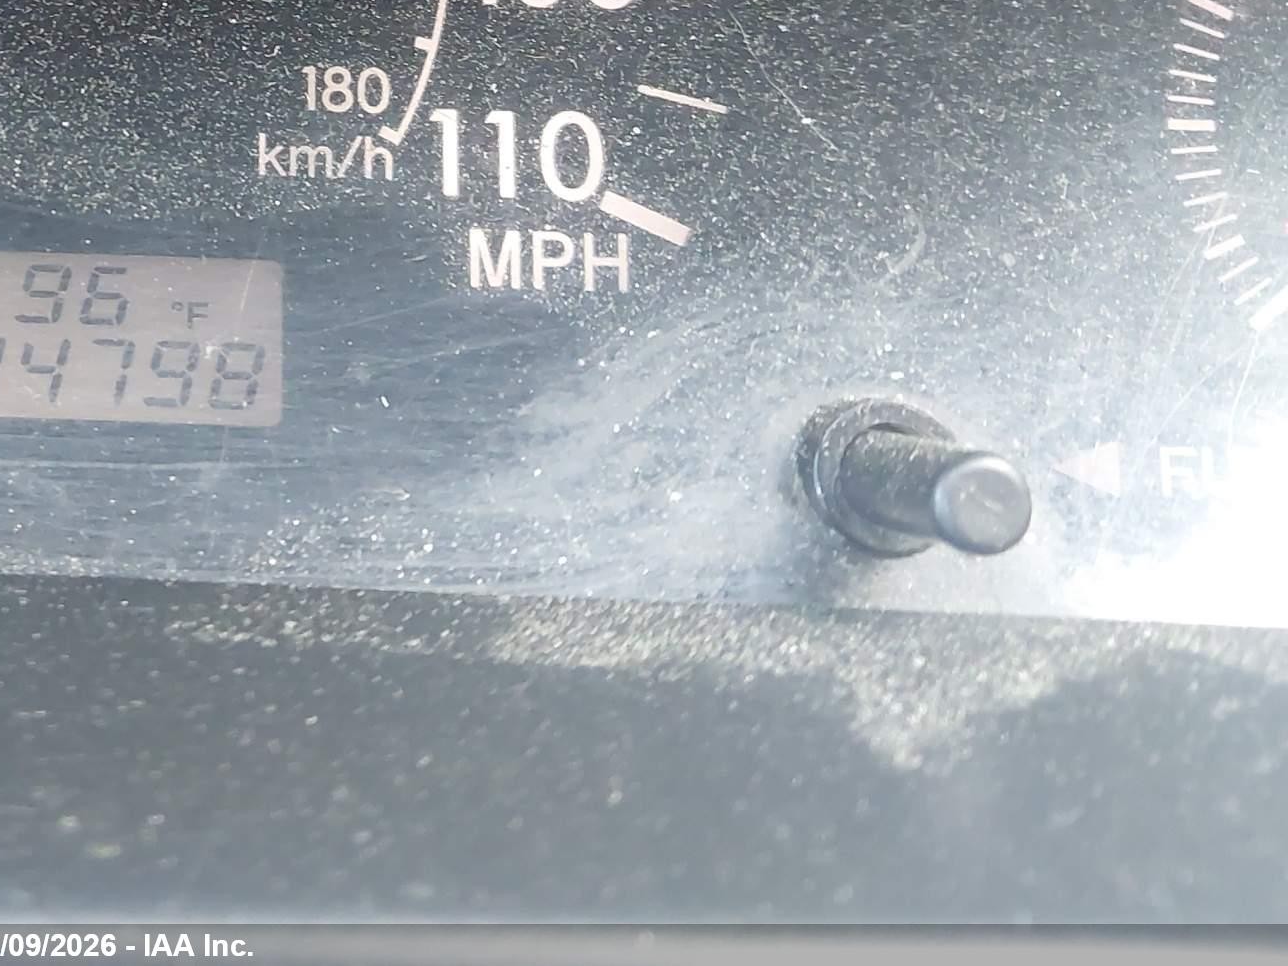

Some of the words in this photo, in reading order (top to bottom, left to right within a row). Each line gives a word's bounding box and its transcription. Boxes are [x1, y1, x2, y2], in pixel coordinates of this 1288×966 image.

[301, 66, 391, 115] 180
[257, 133, 395, 181] km/h
[428, 107, 605, 203] 110
[468, 228, 631, 293] MPH
[15, 264, 130, 326] 96
